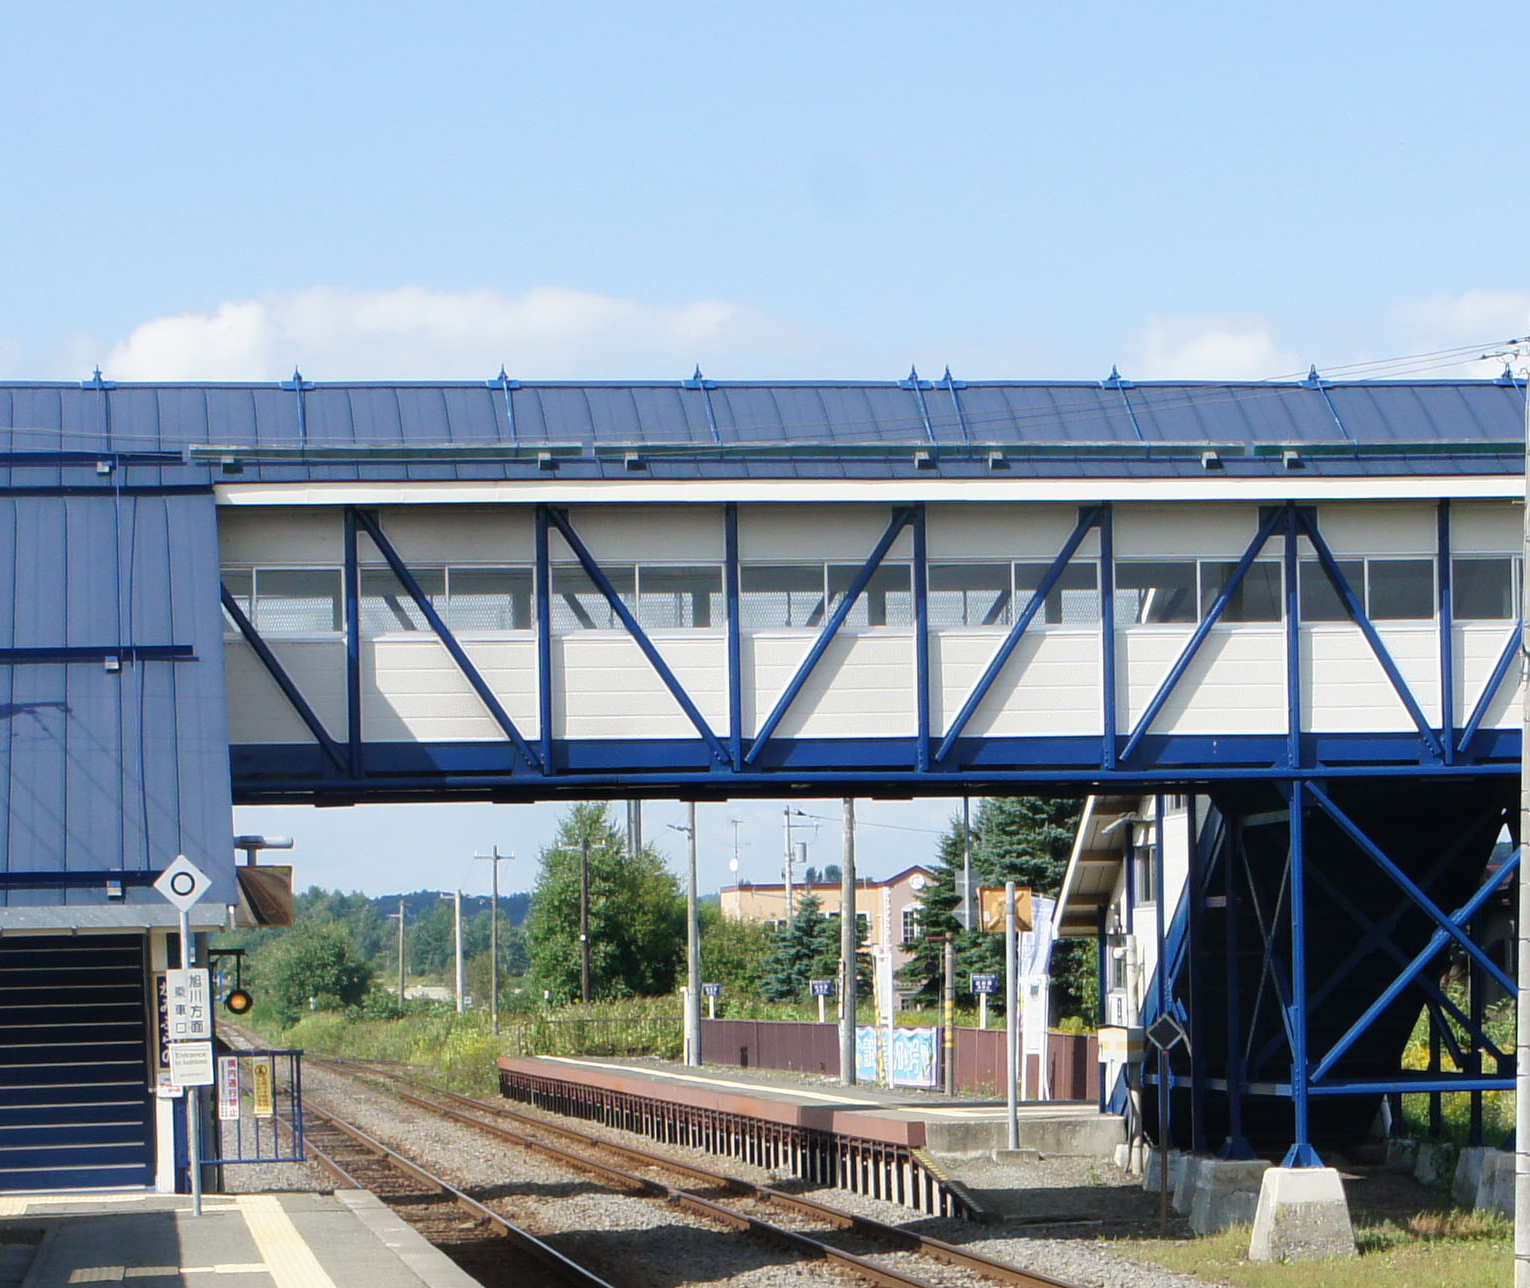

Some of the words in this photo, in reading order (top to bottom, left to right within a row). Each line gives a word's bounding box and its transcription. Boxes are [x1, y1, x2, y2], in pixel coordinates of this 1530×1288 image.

[174, 985, 187, 1034] 乗車口
[189, 974, 204, 1034] 旭川方面
